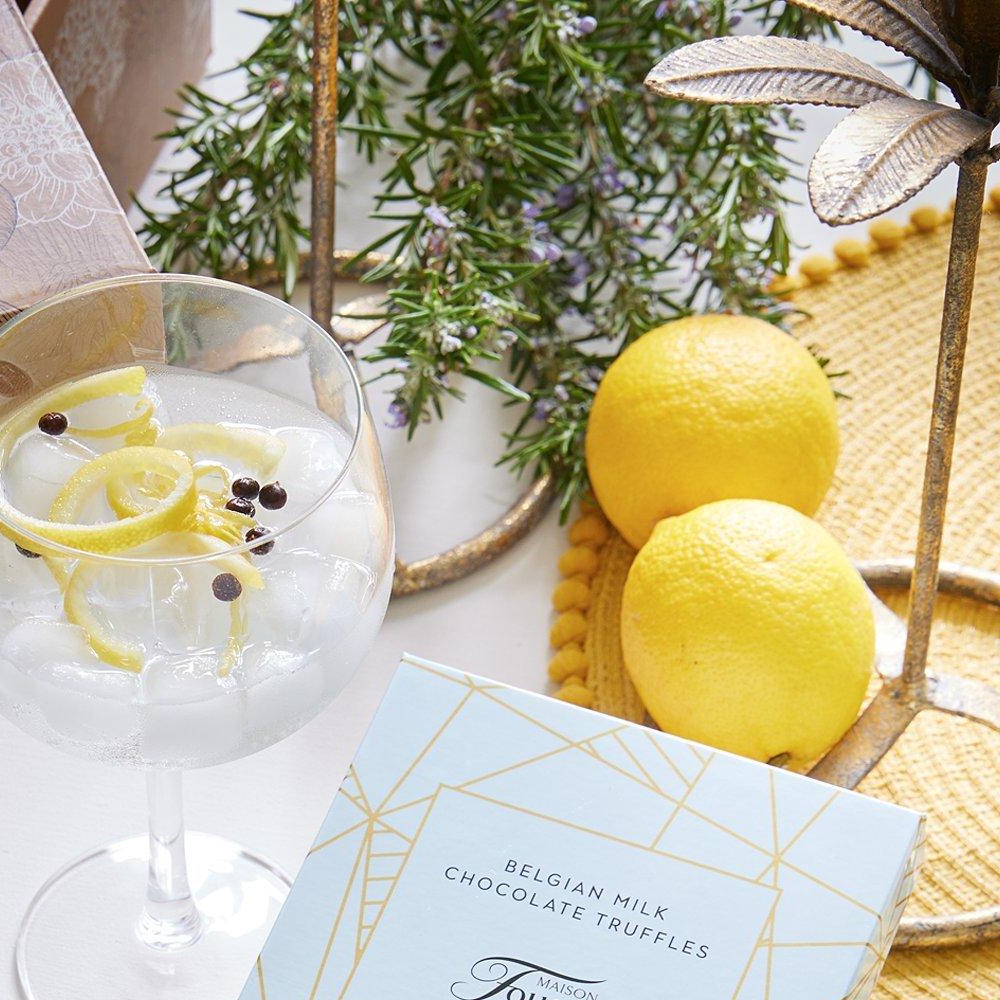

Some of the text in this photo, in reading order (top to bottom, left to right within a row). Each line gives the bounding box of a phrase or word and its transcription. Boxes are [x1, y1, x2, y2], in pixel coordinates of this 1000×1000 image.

[444, 866, 710, 960] CHOCOLATE TRUFFLES
[504, 859, 670, 921] BELGIAN MILK
